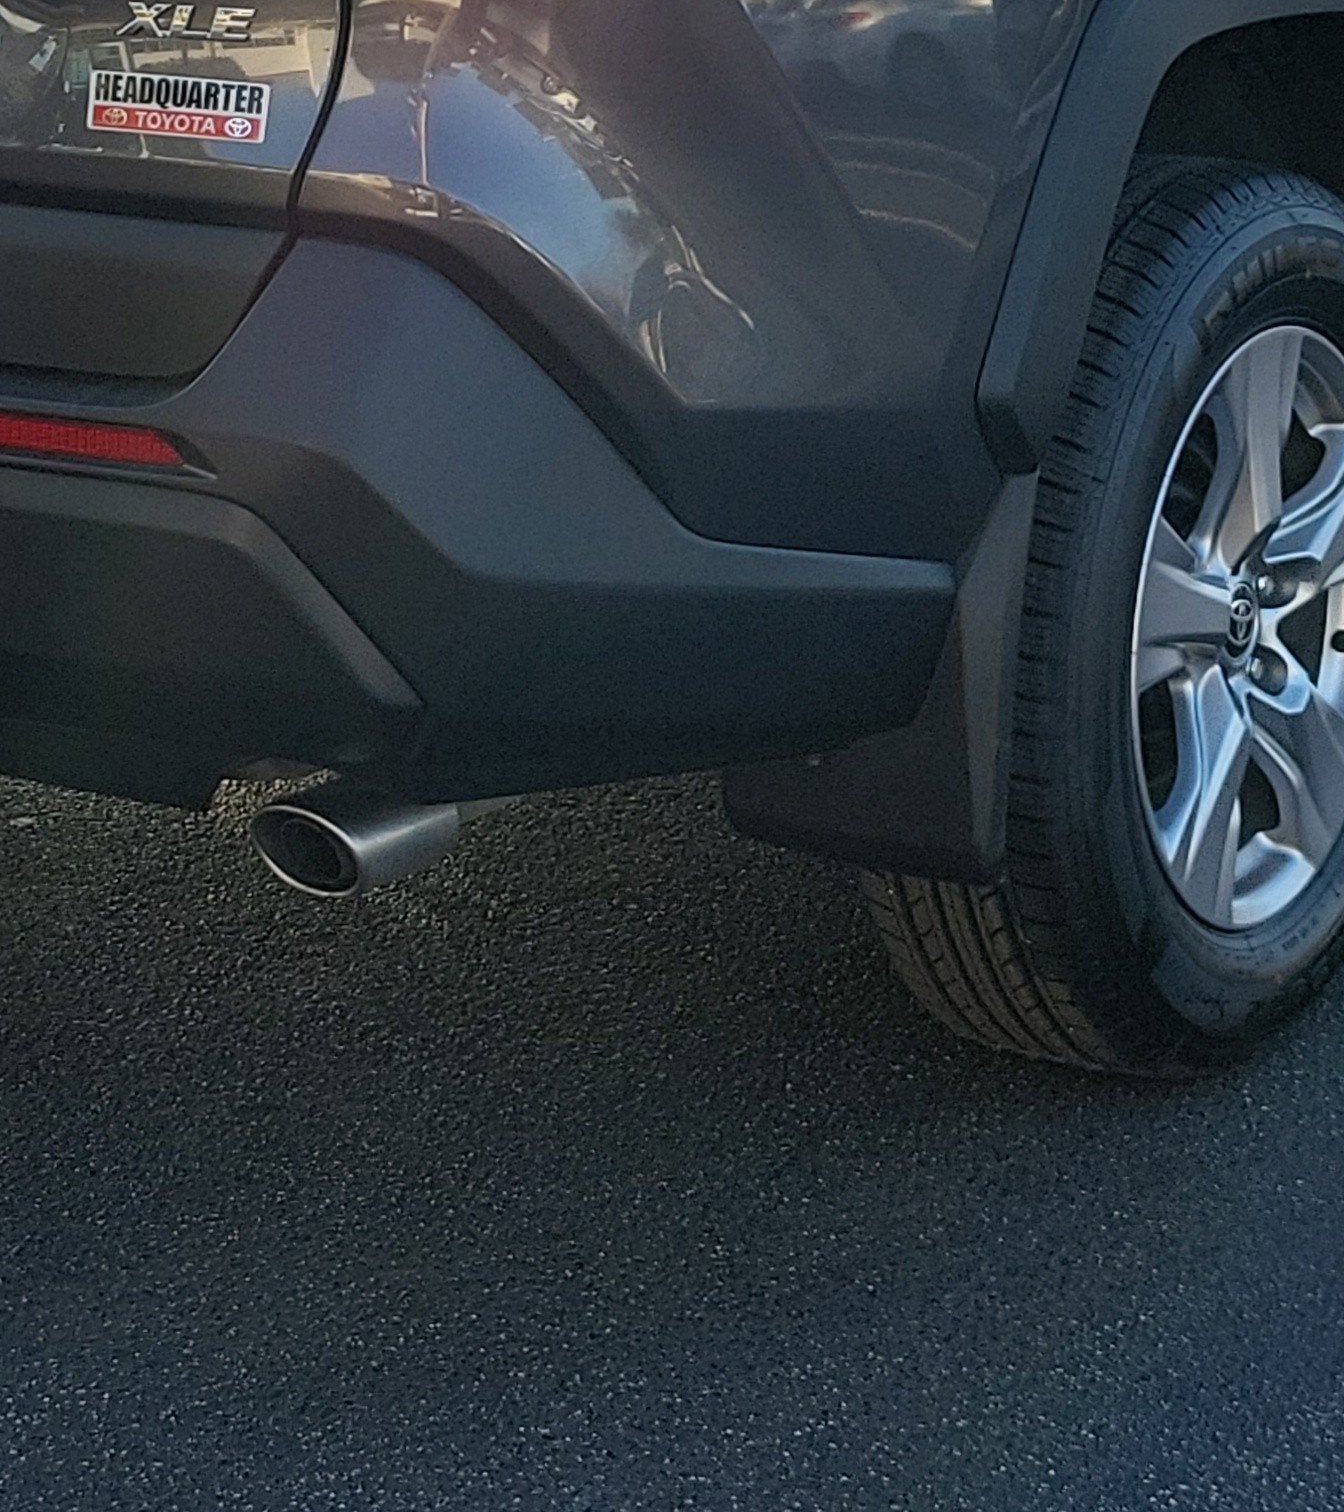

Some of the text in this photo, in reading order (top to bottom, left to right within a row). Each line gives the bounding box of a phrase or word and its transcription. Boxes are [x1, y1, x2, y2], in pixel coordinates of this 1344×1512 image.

[115, 0, 257, 41] XLE
[95, 73, 264, 115] HEADQUARTER
[134, 110, 216, 135] TOYOTA
